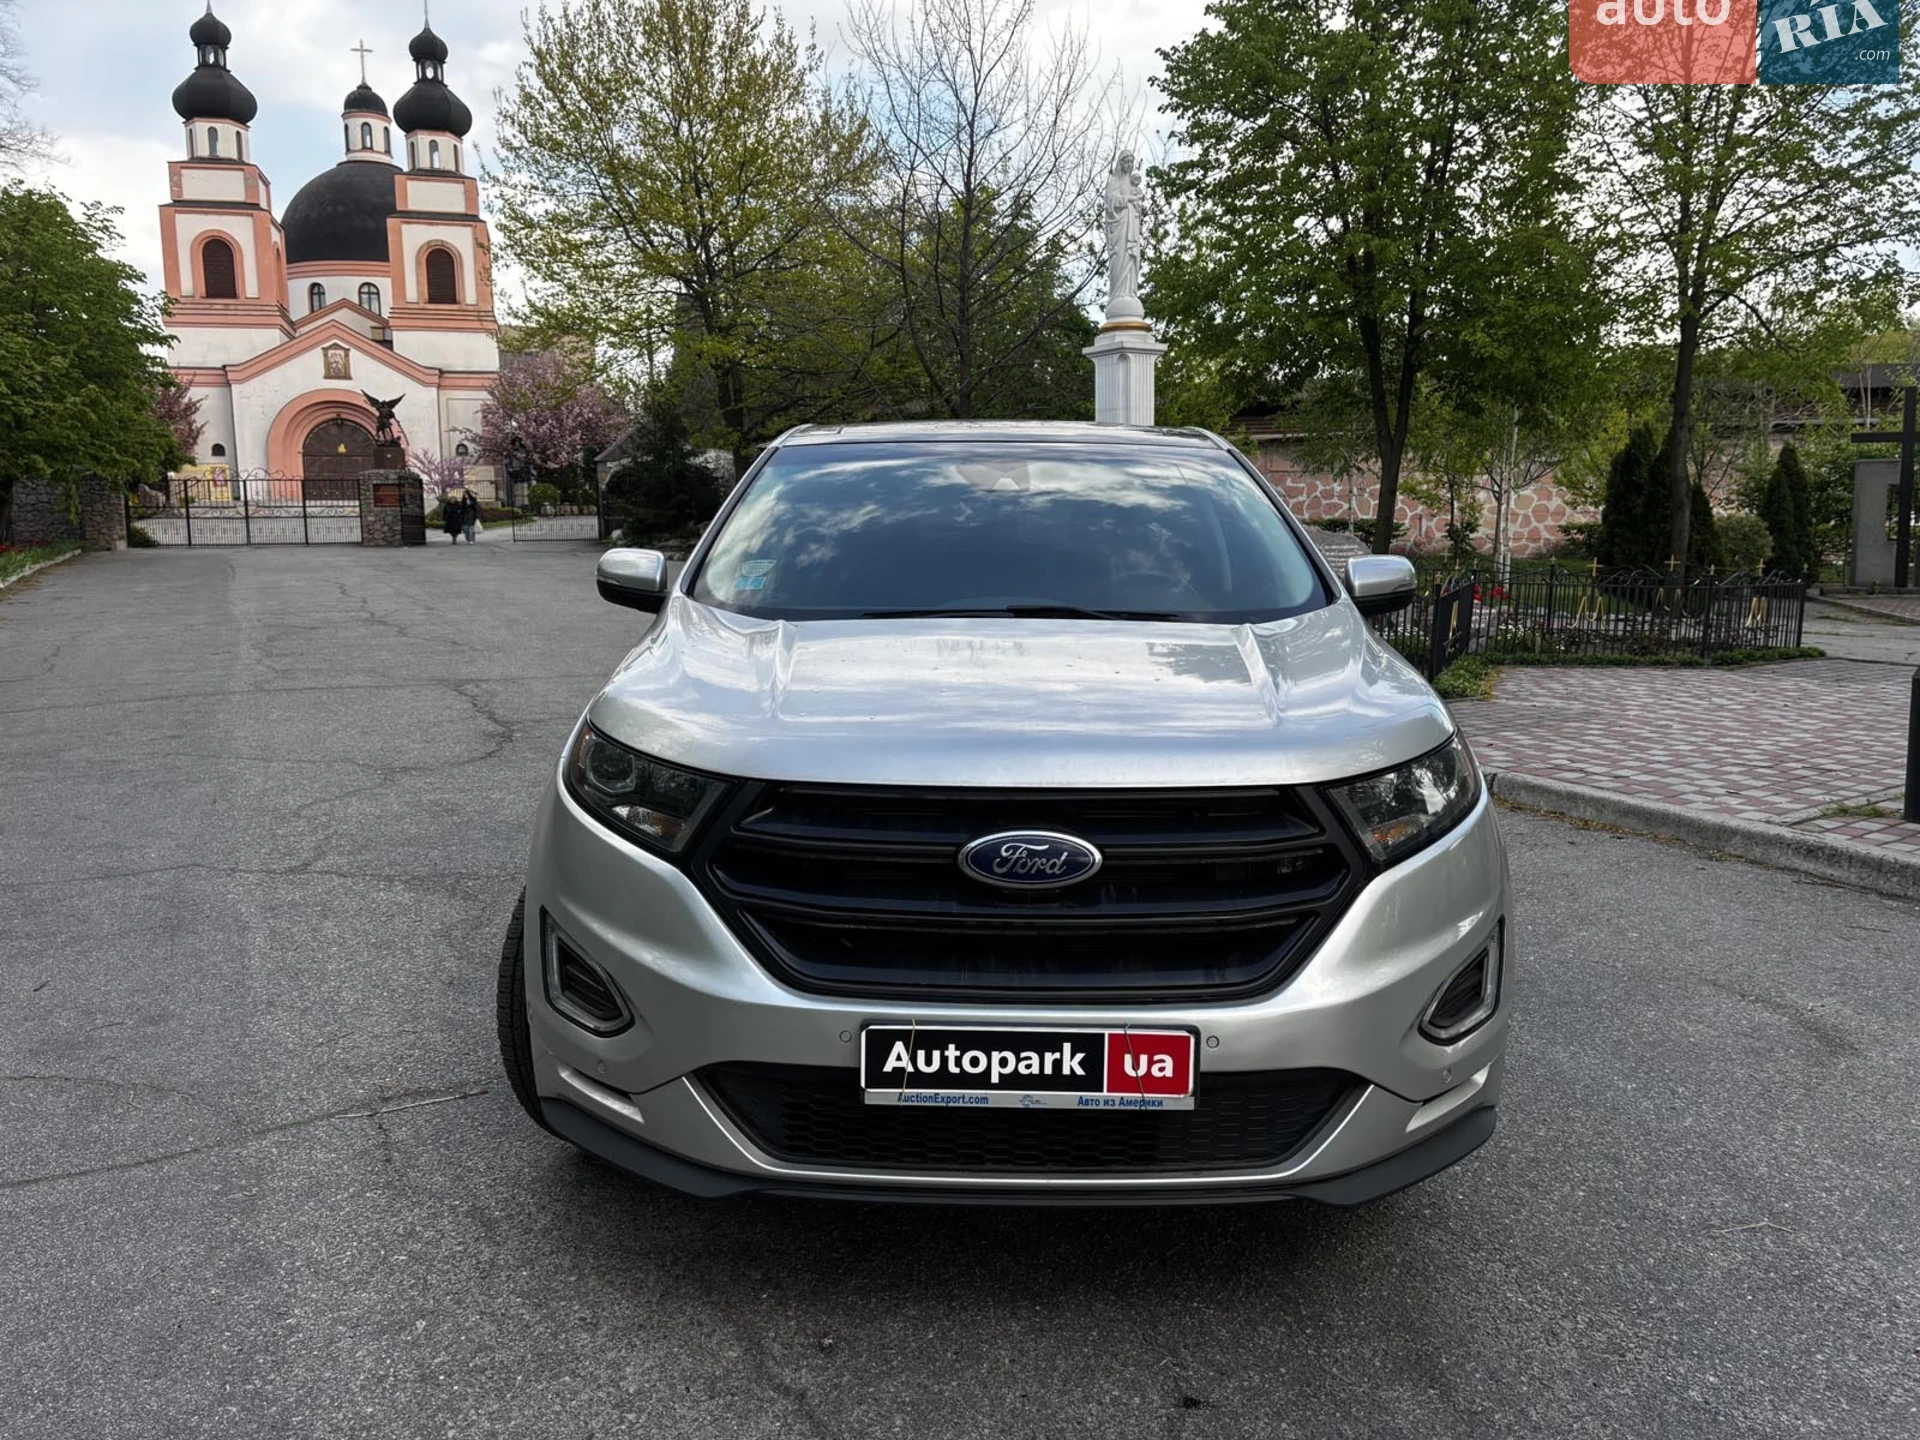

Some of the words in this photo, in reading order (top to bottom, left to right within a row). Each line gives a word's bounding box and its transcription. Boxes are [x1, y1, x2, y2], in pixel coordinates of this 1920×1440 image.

[992, 842, 1069, 875] Ford
[882, 1040, 1087, 1084] Autopark
[1123, 1052, 1174, 1079] ua
[897, 1092, 989, 1107] AuctionExport.com
[1077, 1095, 1100, 1107] Авто
[1103, 1098, 1116, 1107] из
